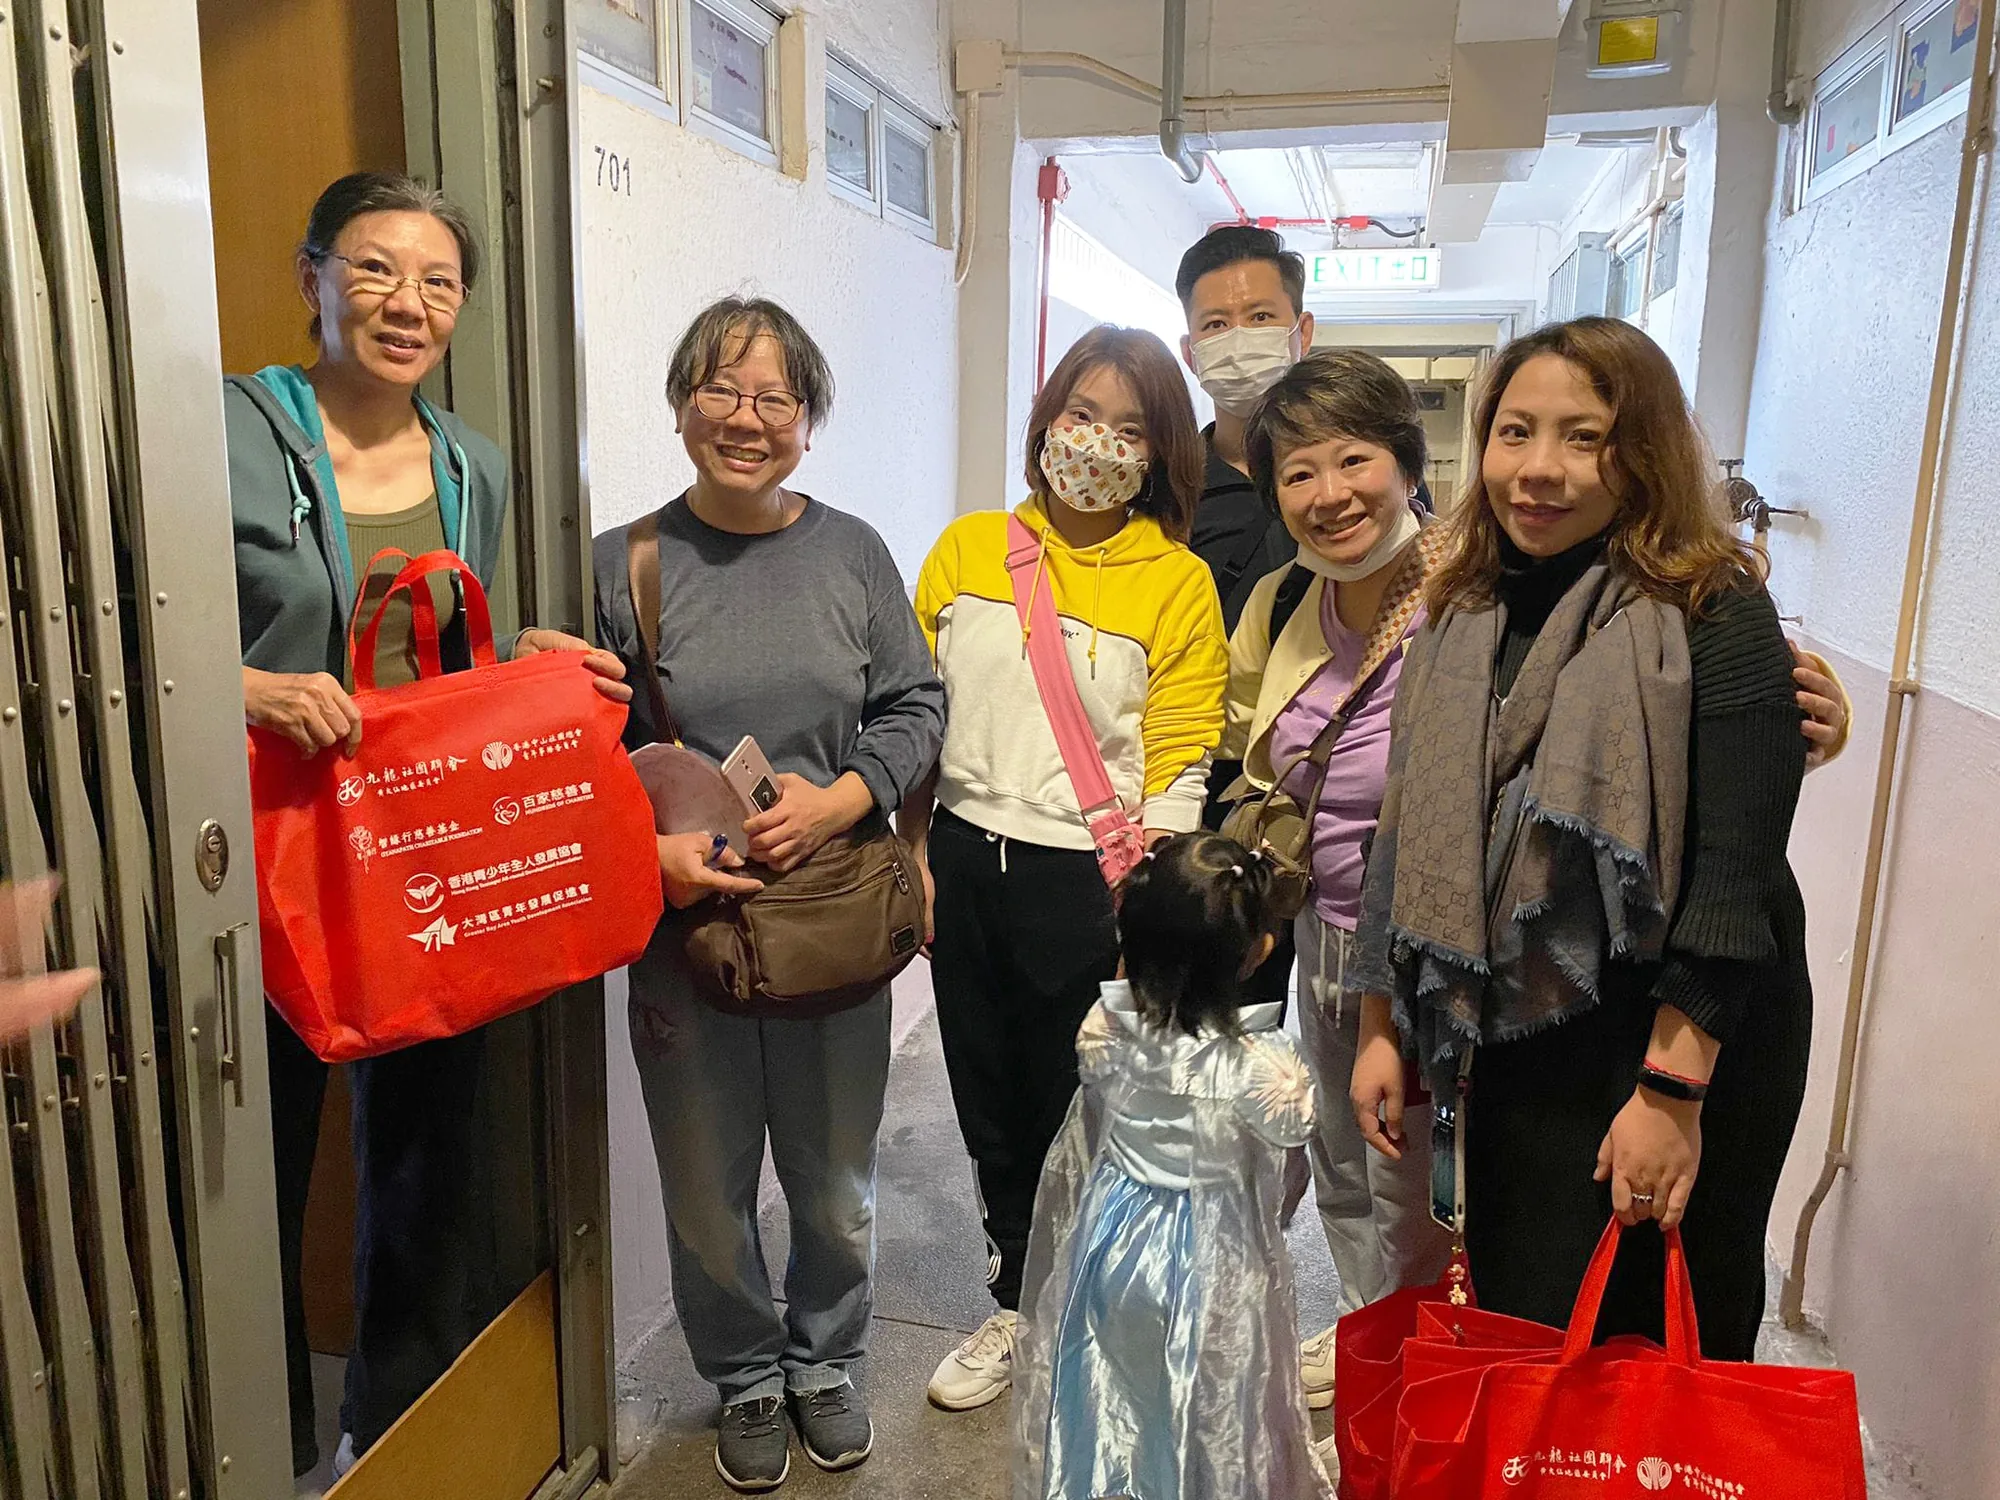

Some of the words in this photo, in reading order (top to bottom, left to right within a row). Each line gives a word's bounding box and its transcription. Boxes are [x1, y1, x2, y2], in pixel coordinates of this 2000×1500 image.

[594, 145, 631, 196] 701
[1313, 256, 1382, 282] EXIT
[521, 780, 593, 809] 百家慈善會
[447, 842, 583, 889] 香港青少年全人發展協會
[461, 883, 591, 929] 大灣區青年發展促進會
